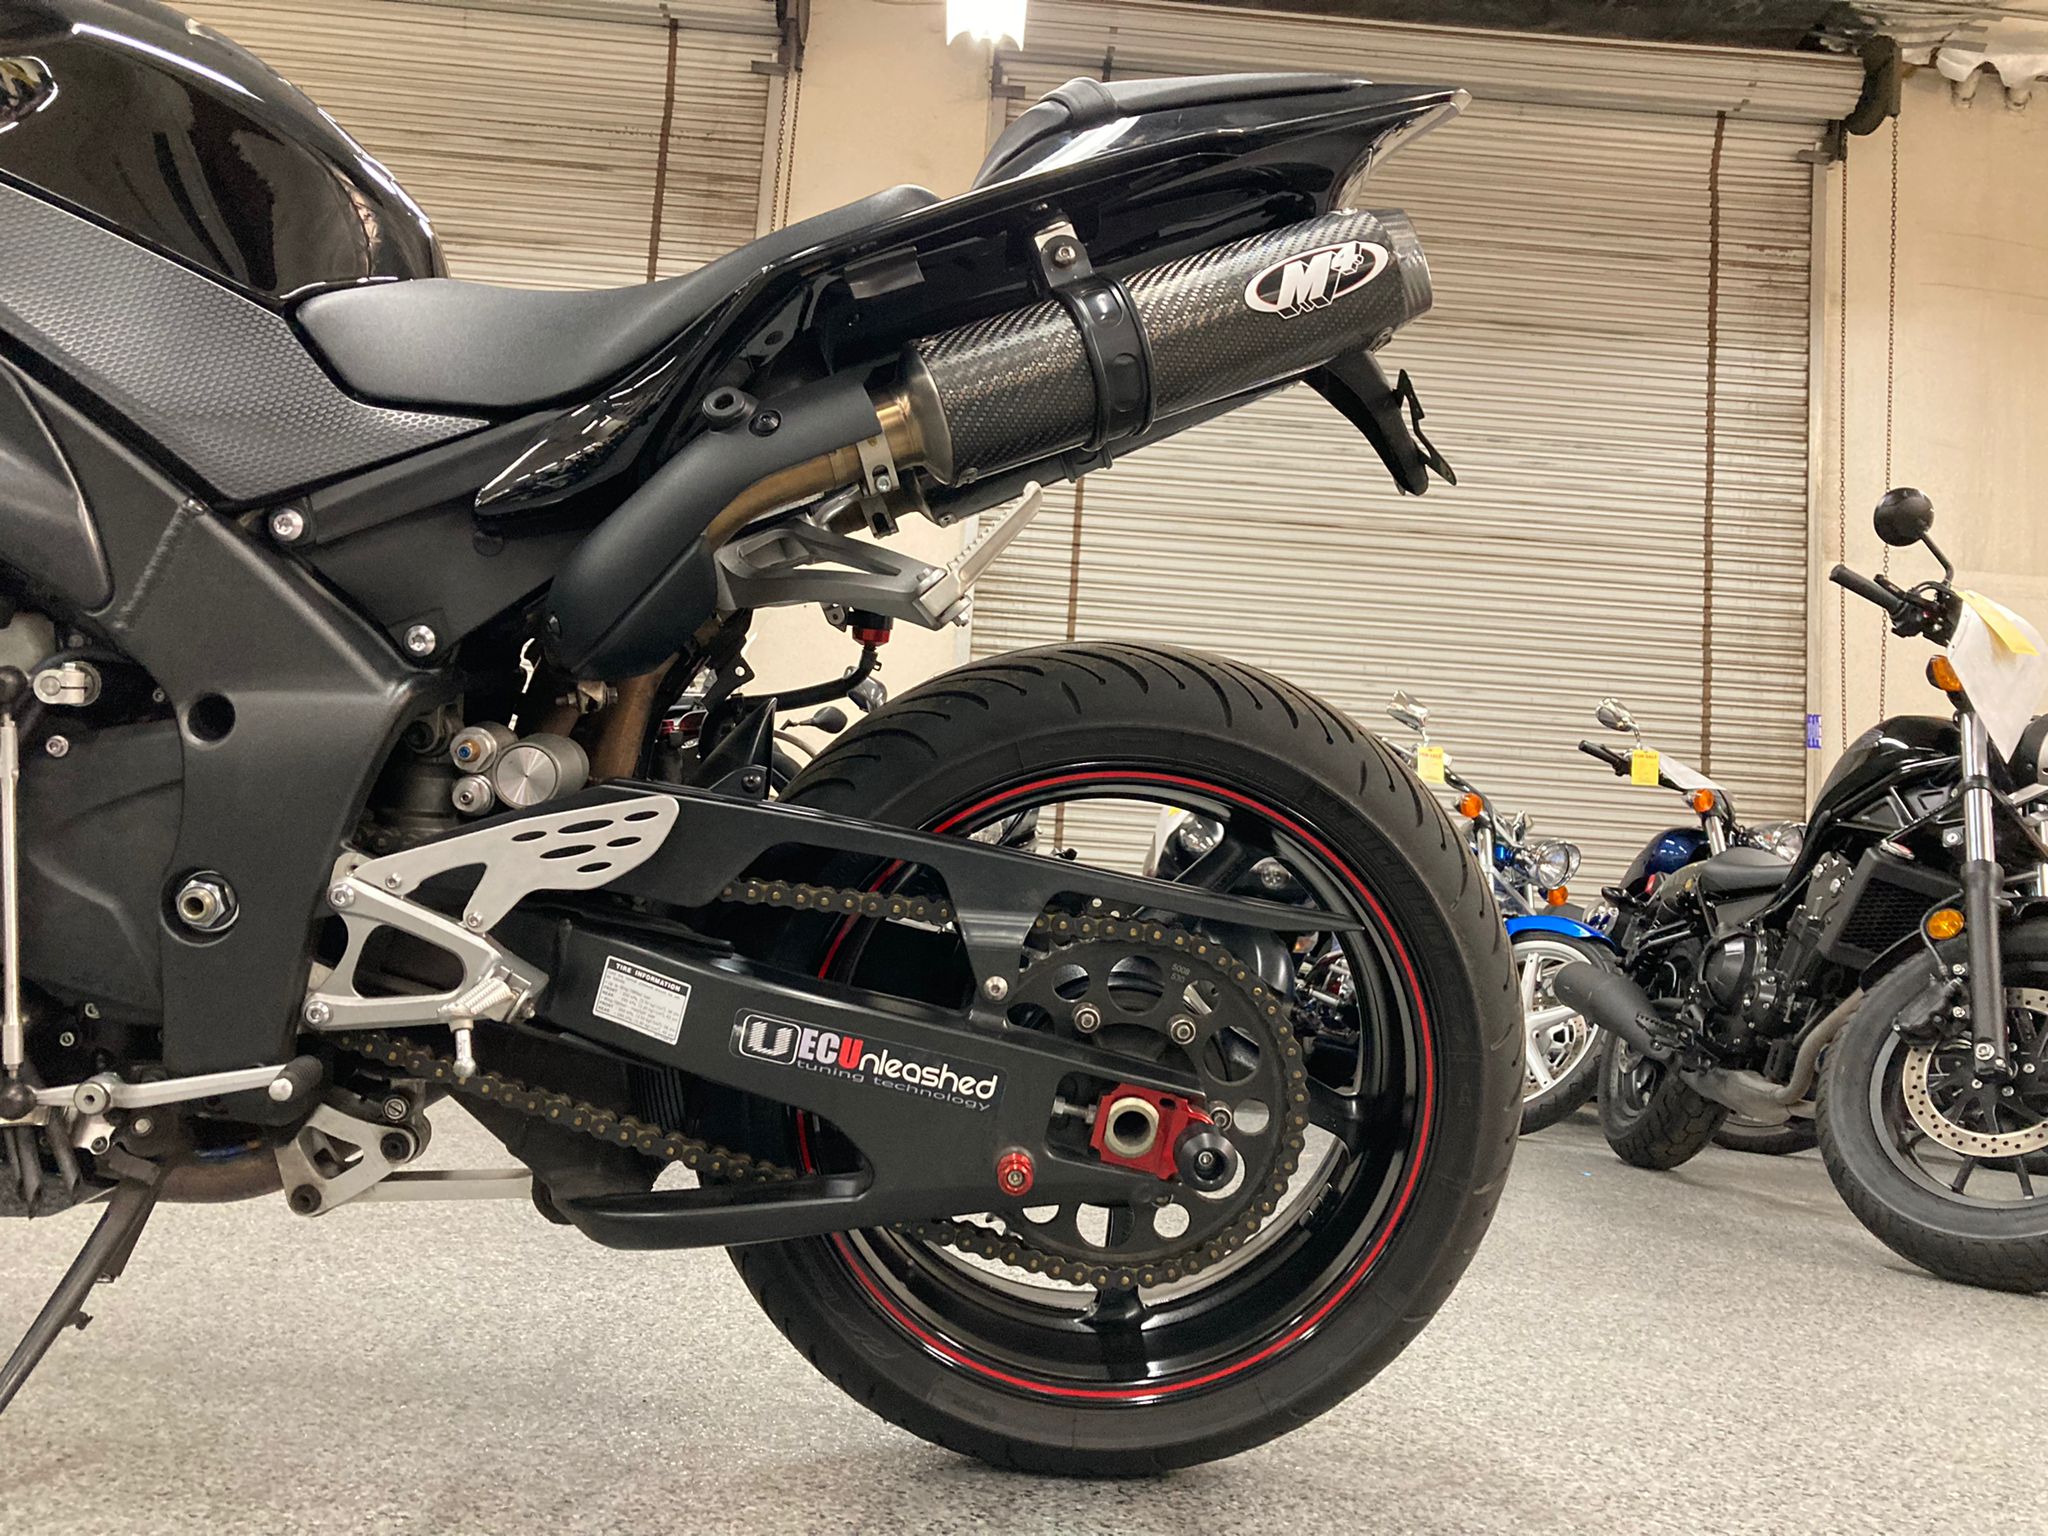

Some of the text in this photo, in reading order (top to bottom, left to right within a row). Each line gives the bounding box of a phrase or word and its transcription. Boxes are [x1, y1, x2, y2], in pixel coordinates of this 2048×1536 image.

[1276, 241, 1364, 319] M4
[615, 962, 632, 974] TIRE
[634, 969, 681, 992] INFORMATION
[797, 1028, 998, 1100] ECUnleashed
[797, 1060, 992, 1112] tuning technology
